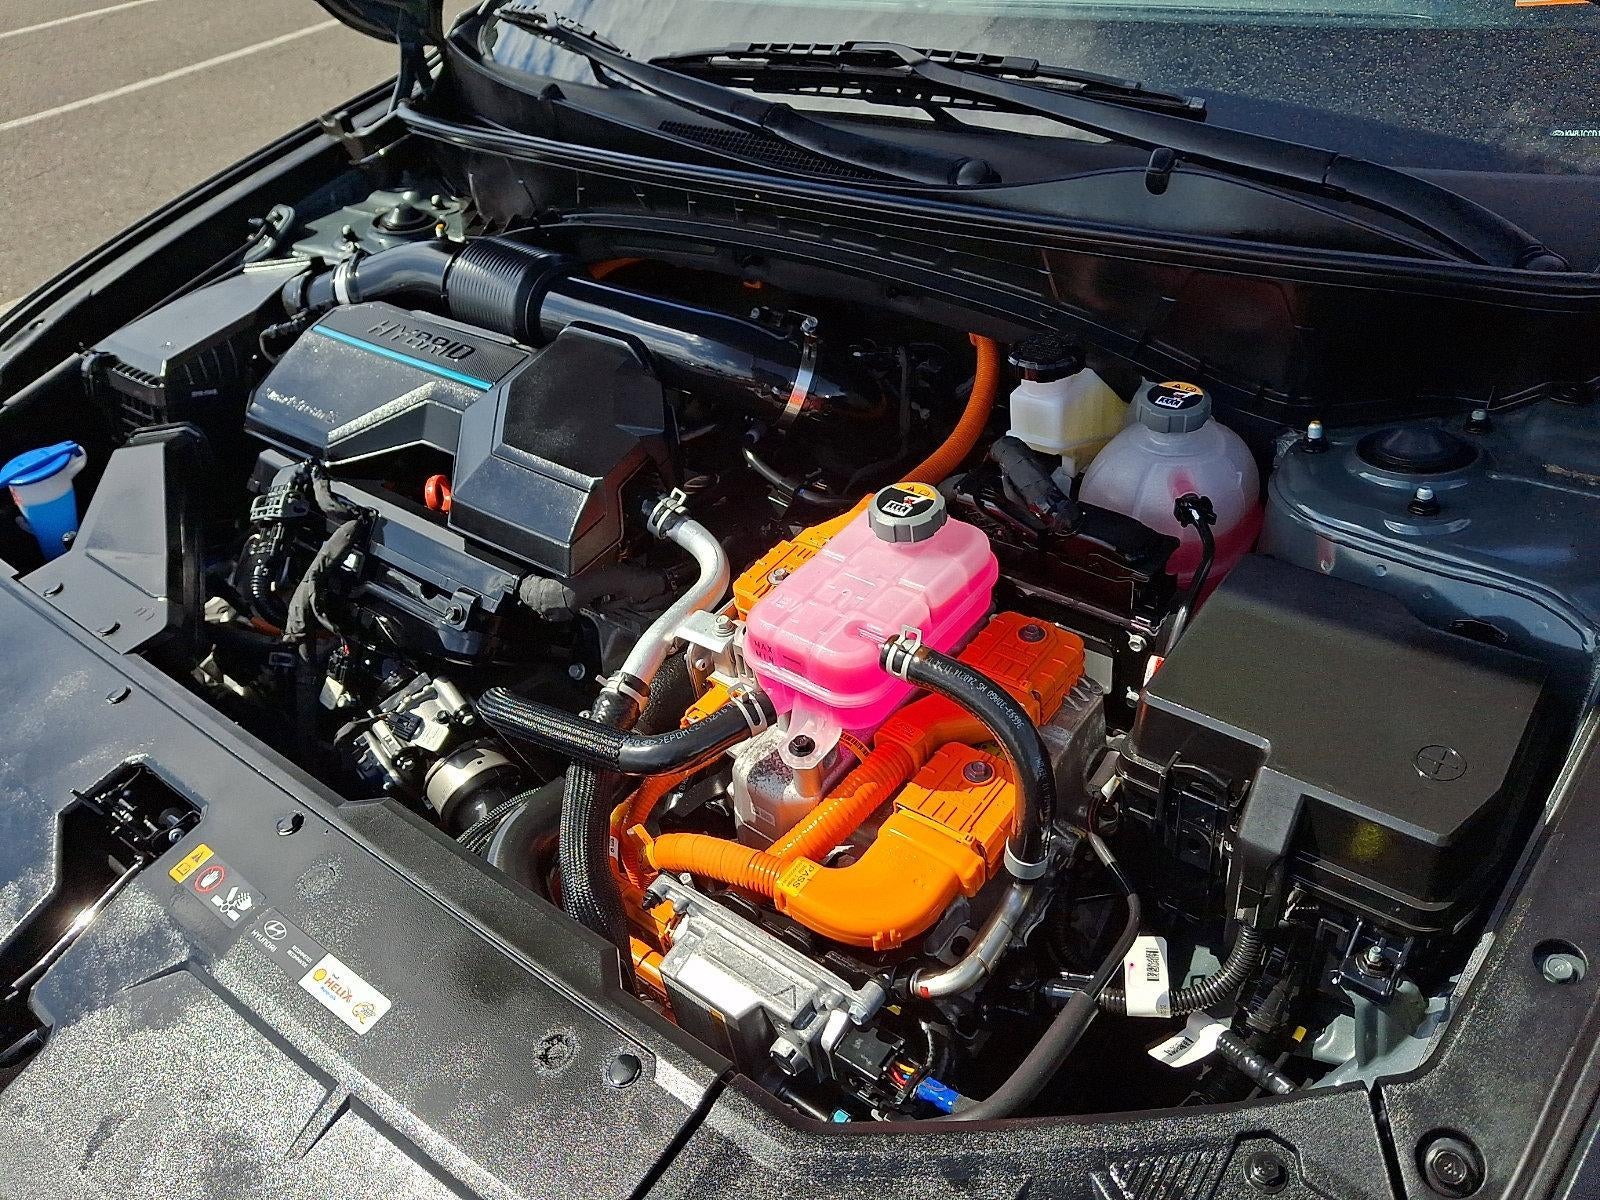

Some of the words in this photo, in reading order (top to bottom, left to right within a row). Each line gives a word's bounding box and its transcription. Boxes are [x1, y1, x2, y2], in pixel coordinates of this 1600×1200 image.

[367, 319, 476, 359] HYBRID
[754, 640, 773, 654] MAX
[755, 650, 774, 665] MIN
[792, 864, 815, 888] PASS
[251, 929, 278, 952] HYUNDAI
[325, 977, 352, 1002] HELIX
